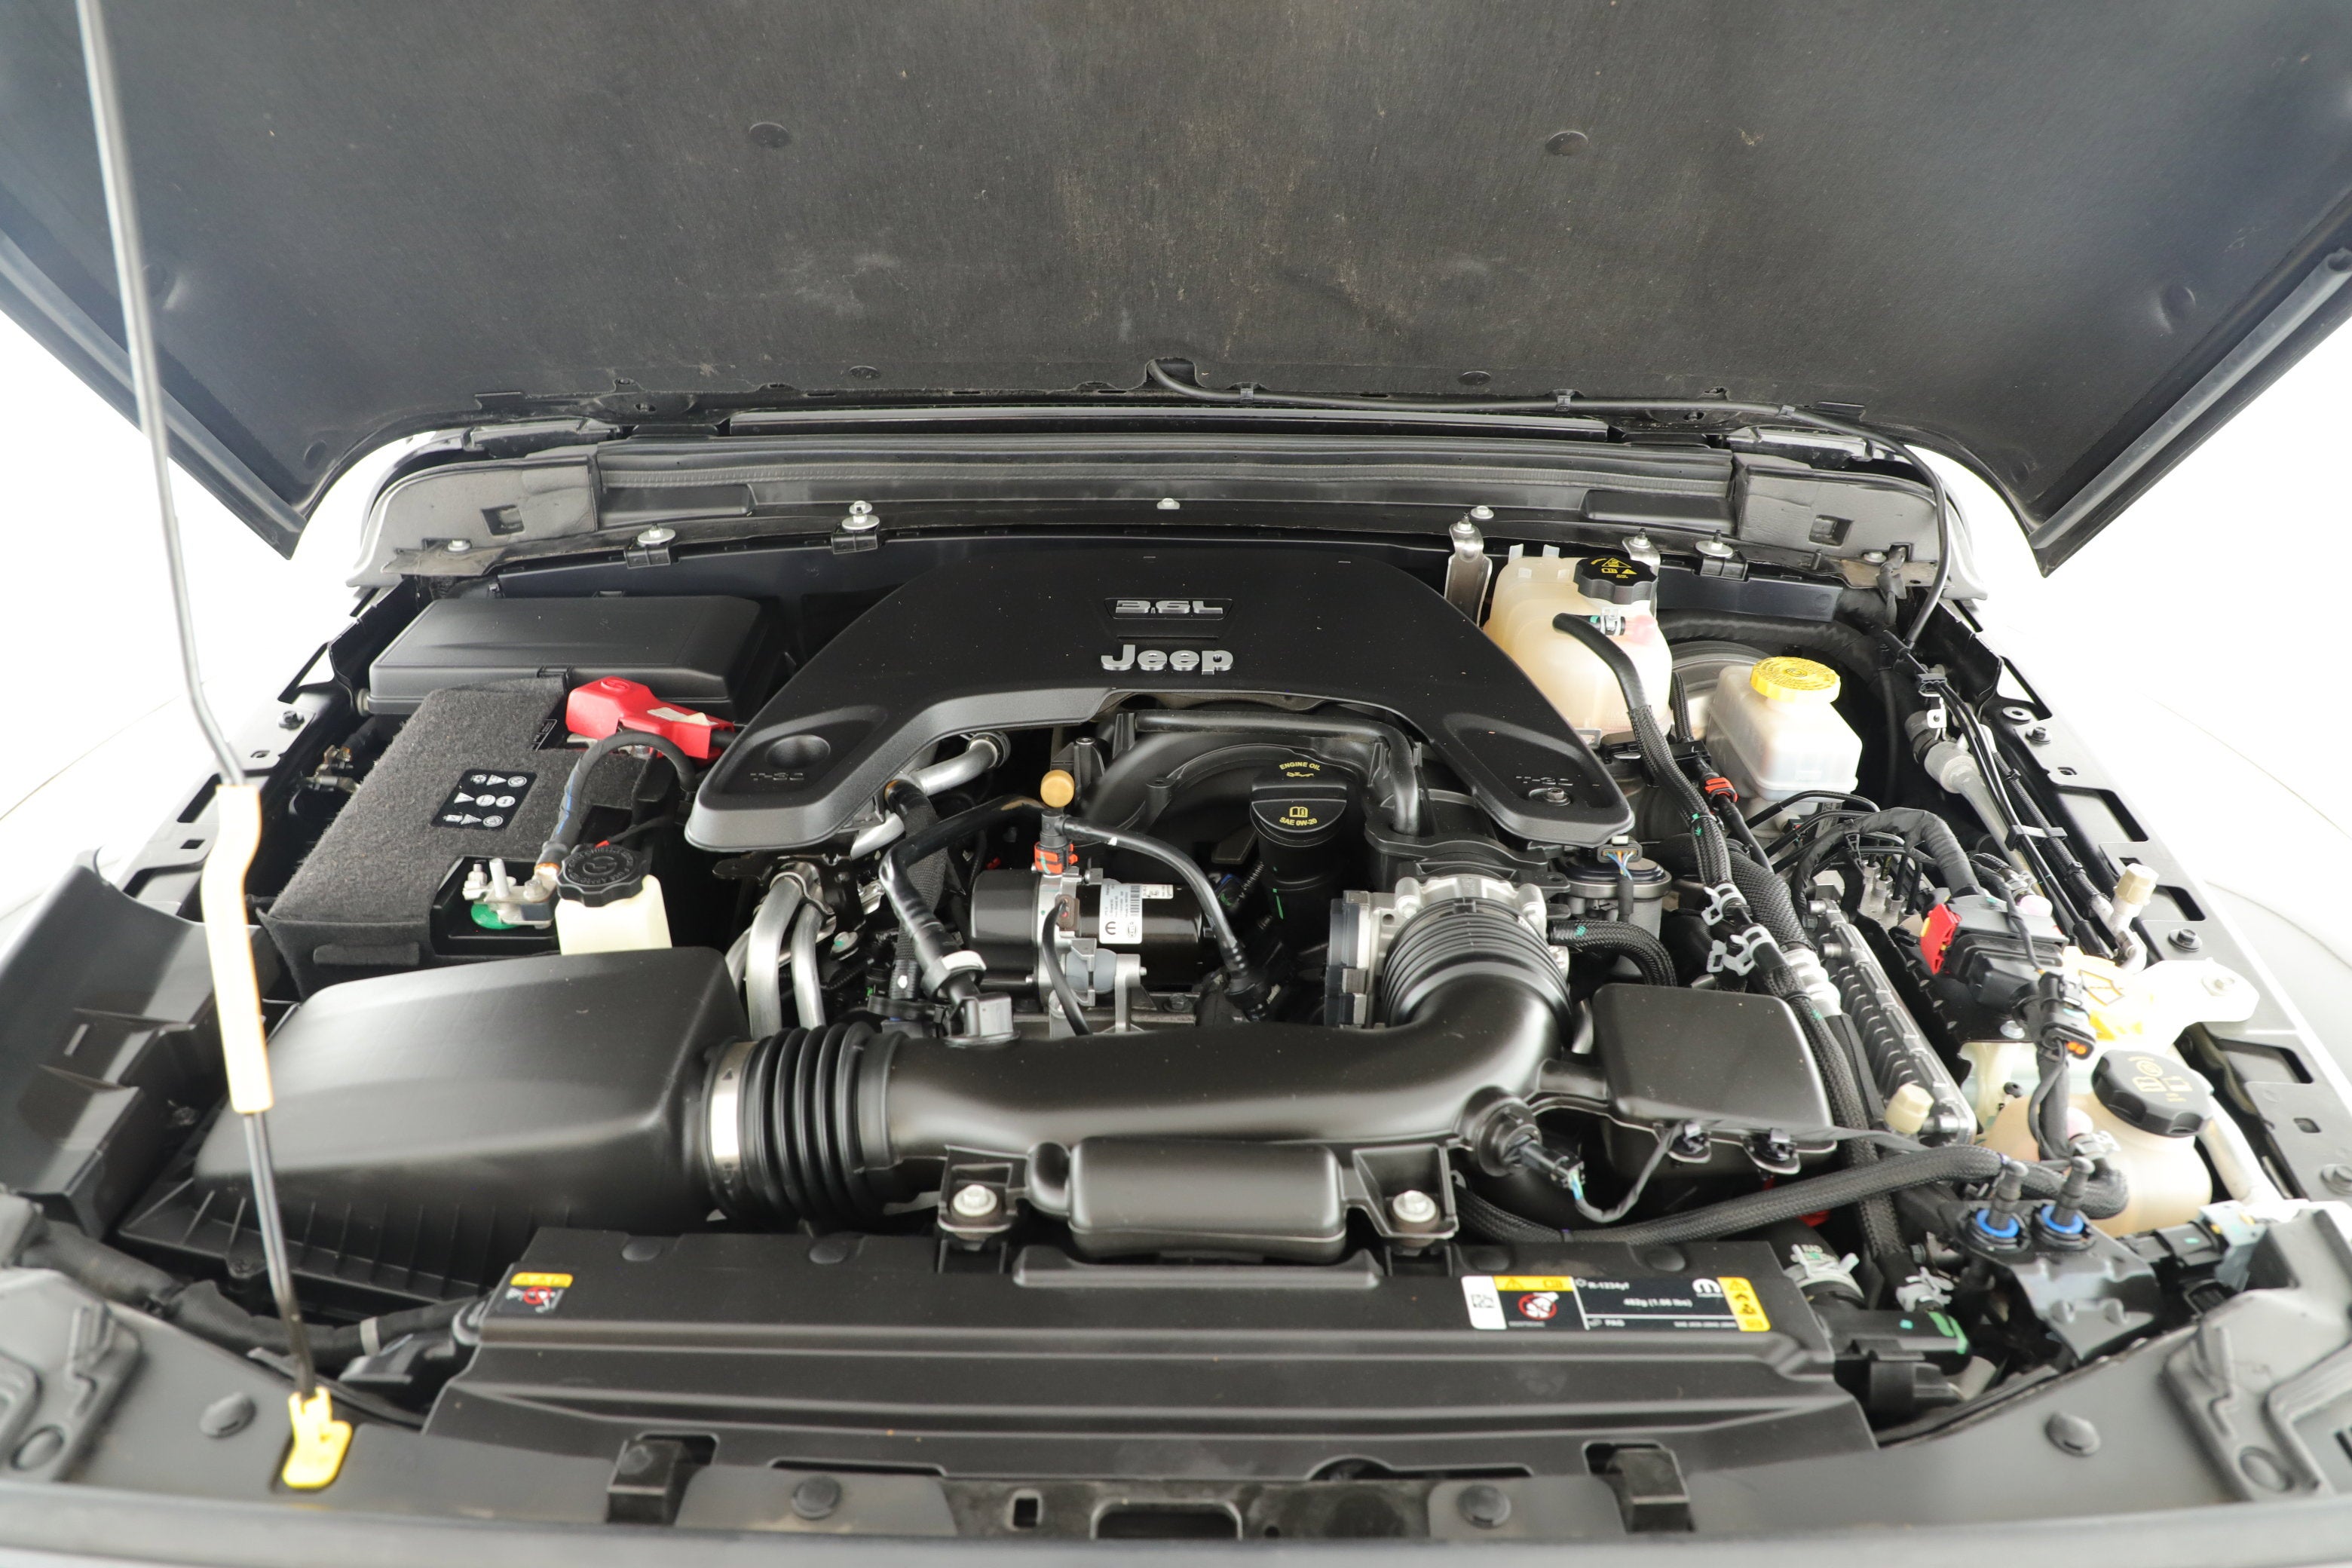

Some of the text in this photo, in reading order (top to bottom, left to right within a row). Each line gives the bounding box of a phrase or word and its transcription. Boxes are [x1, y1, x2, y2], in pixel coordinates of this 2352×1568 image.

[1115, 600, 1223, 614] 3.6L
[1101, 644, 1233, 675] Jeep
[1279, 761, 1308, 770] ENGINE
[1279, 816, 1318, 826] SAE 0W-20
